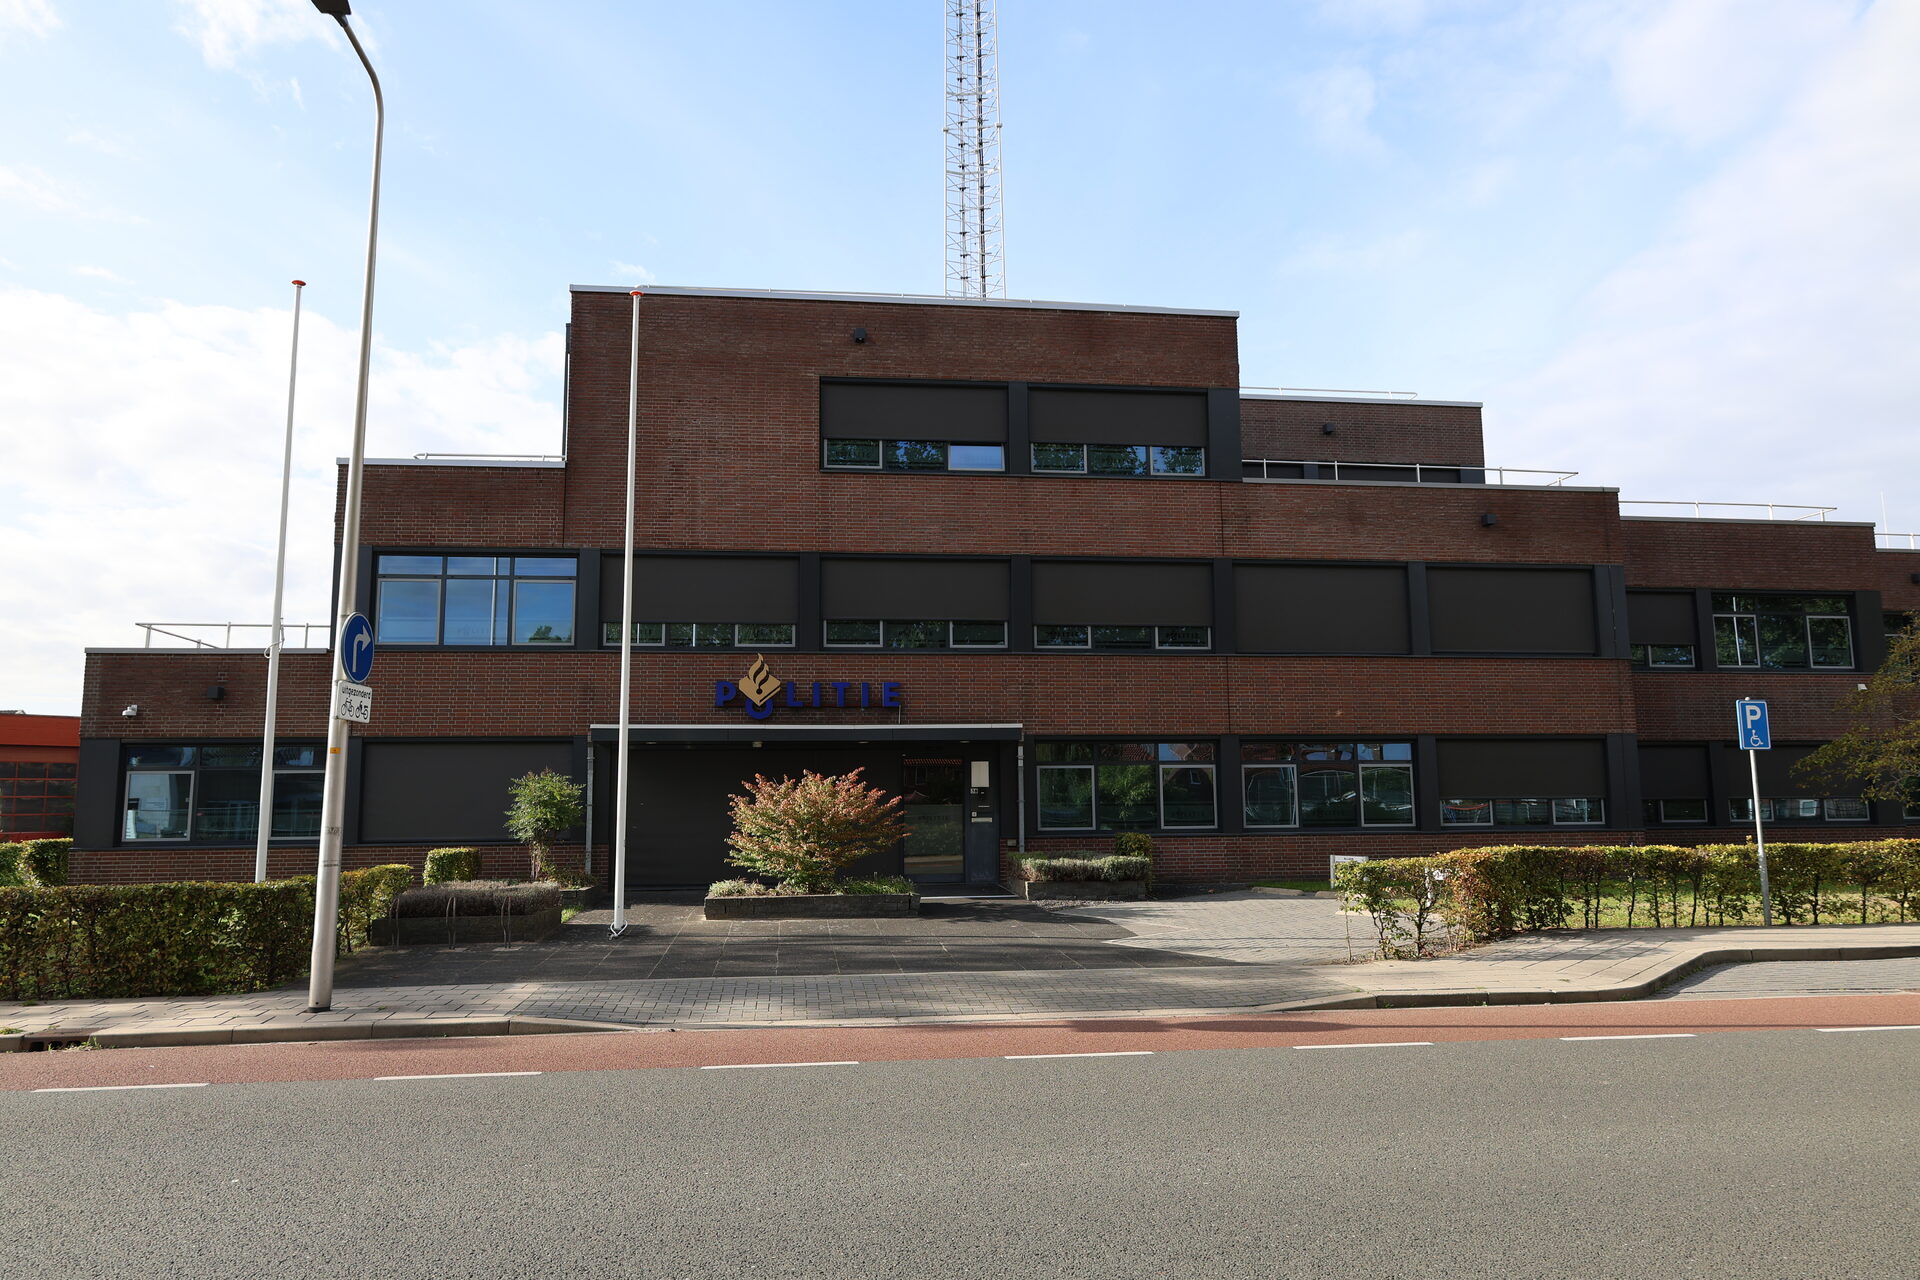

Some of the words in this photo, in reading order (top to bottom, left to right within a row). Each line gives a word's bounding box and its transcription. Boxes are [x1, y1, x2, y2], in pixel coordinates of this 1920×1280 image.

[342, 686, 371, 700] uitgezonderd
[714, 681, 901, 720] POLITIE
[1745, 704, 1762, 729] P
